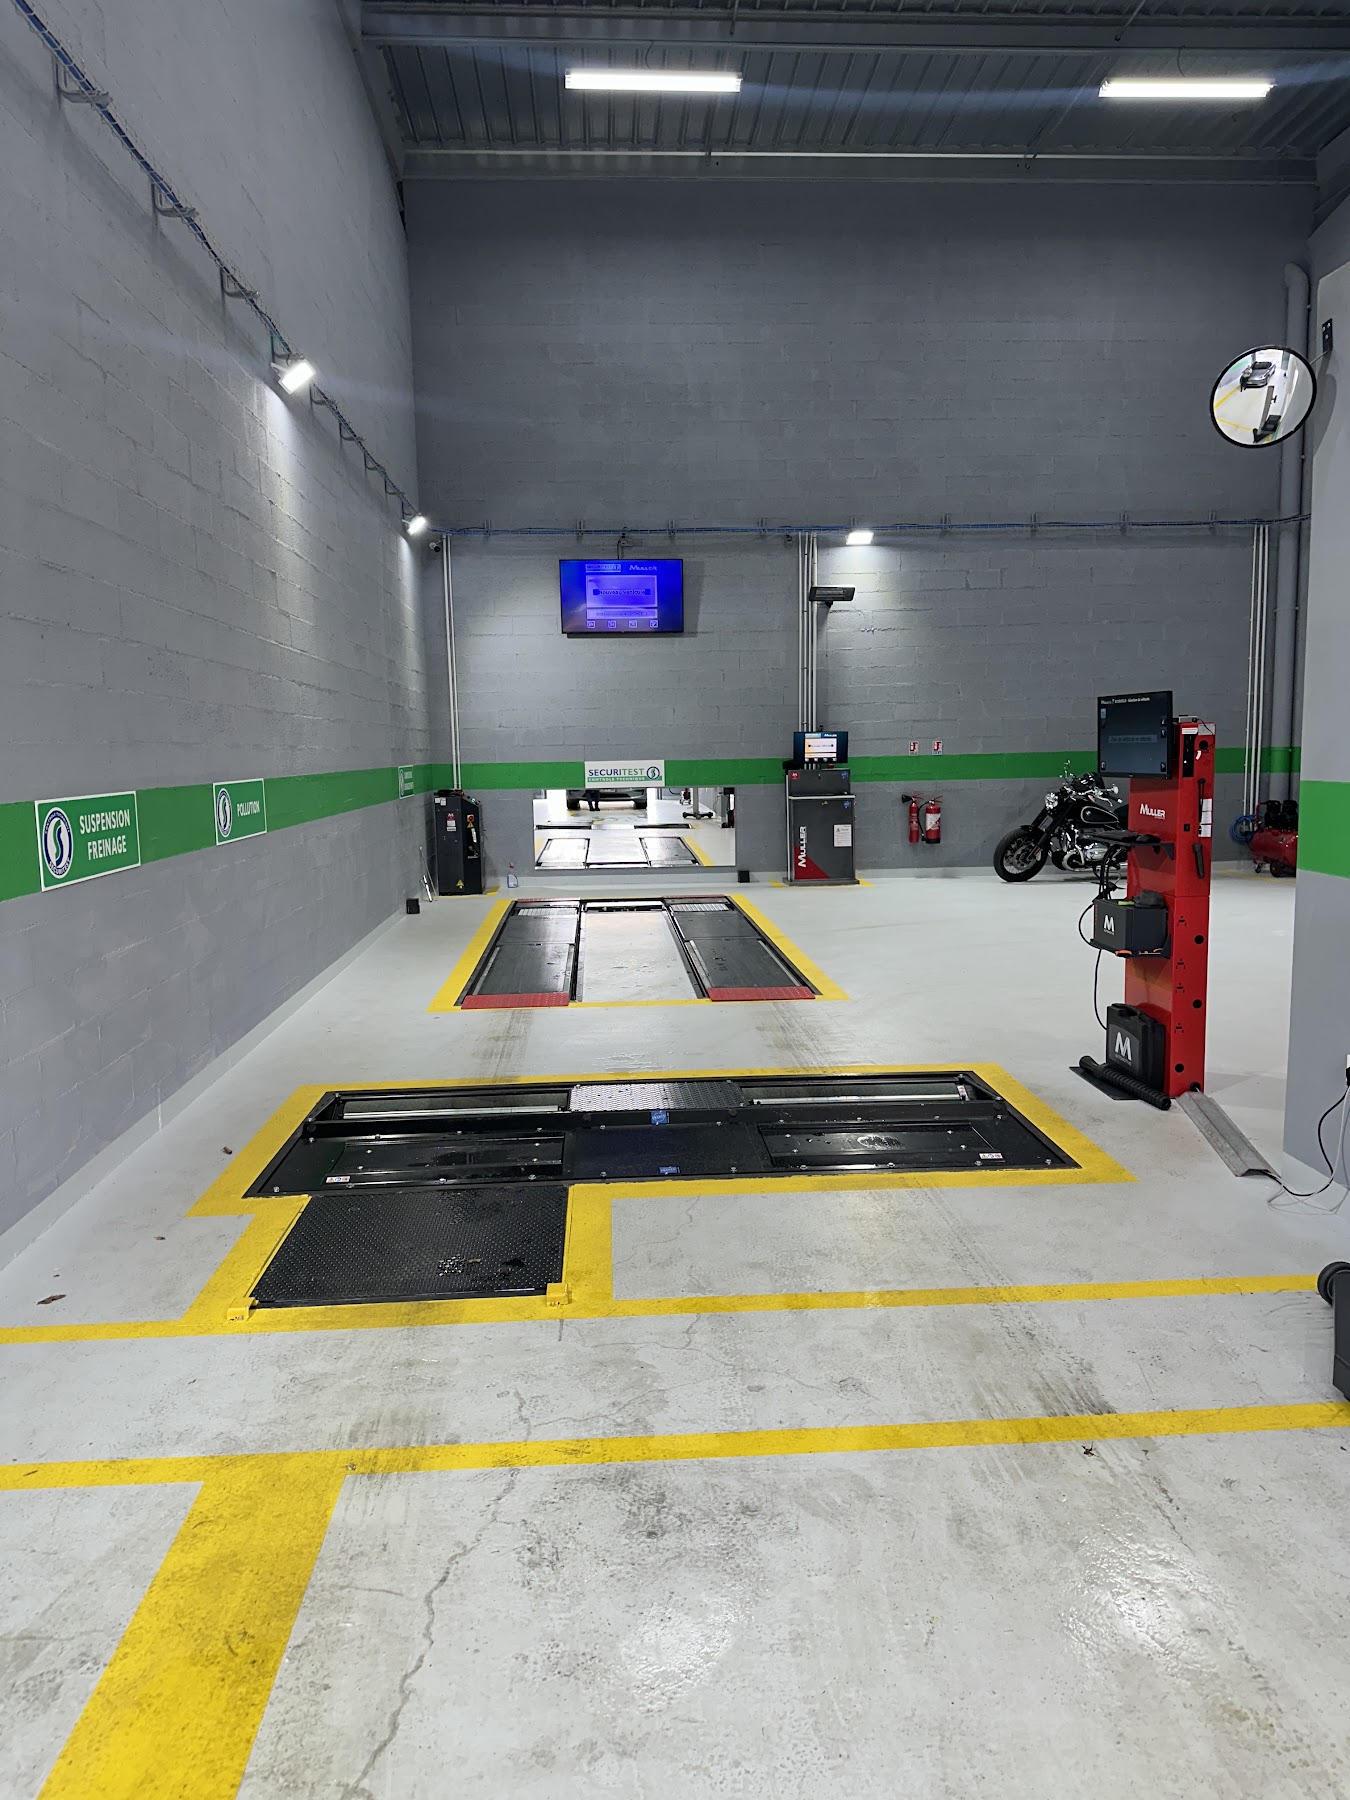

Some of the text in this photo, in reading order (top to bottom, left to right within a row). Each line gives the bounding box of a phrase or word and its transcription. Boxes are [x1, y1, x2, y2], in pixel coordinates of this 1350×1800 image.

[588, 768, 645, 777] SECURITEST
[79, 808, 131, 835] SUSPENSION
[236, 800, 261, 817] POLLUTION
[1139, 803, 1166, 818] MULLER
[87, 835, 127, 861] FREINAGE
[797, 826, 807, 868] MULLER
[1114, 1031, 1132, 1061] M
